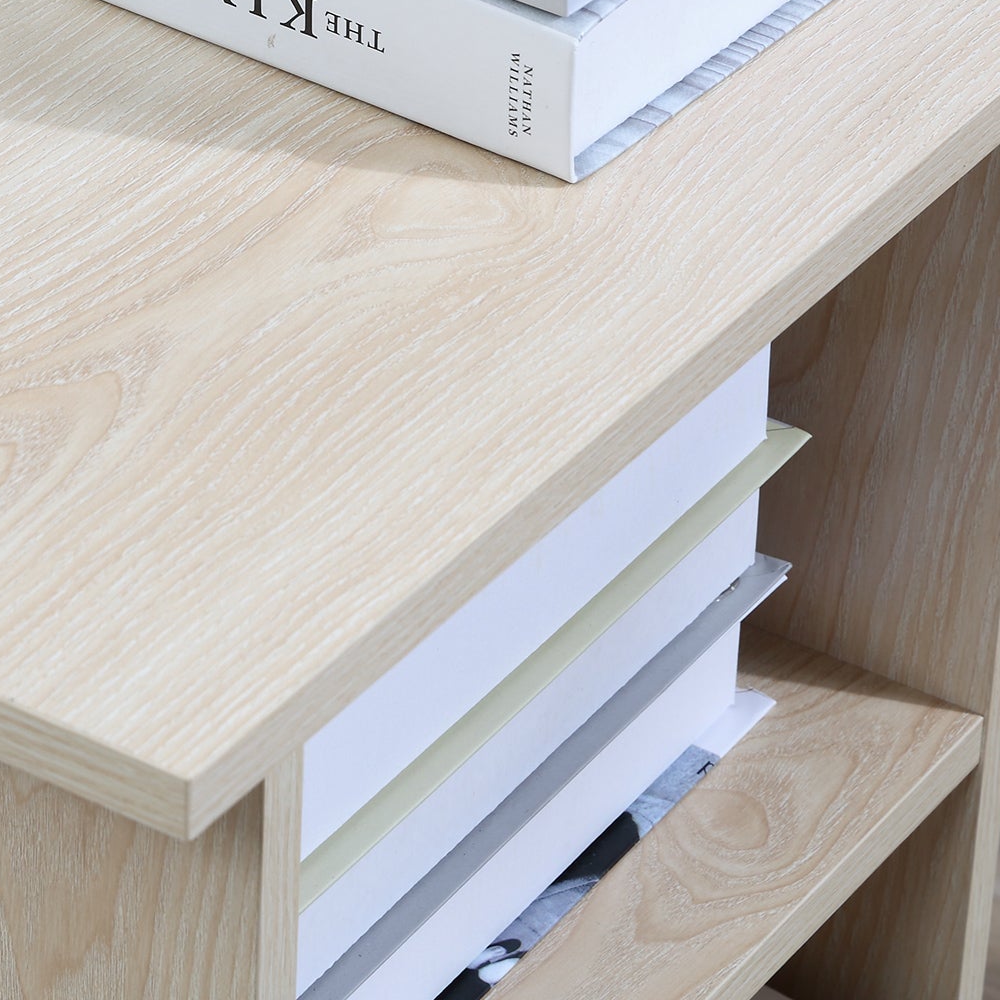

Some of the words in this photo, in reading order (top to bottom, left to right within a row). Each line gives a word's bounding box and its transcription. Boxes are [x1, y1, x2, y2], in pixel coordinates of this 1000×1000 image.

[324, 10, 385, 54] THE
[508, 53, 520, 138] WILLIAMS
[522, 64, 534, 136] NATHAN
